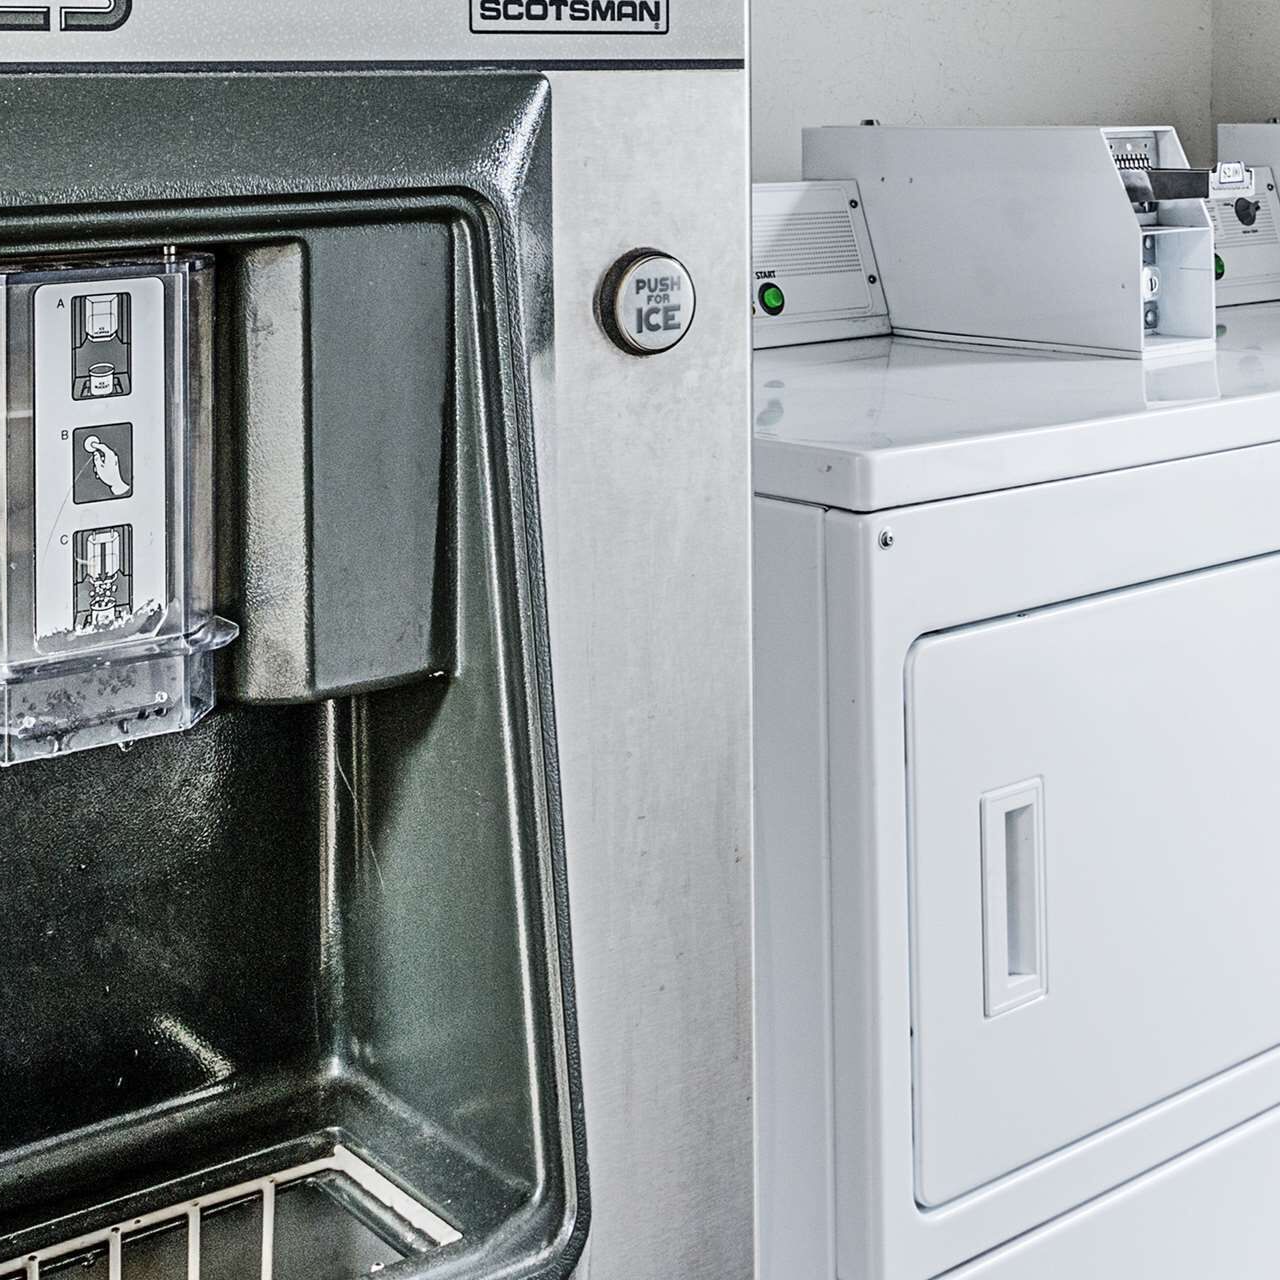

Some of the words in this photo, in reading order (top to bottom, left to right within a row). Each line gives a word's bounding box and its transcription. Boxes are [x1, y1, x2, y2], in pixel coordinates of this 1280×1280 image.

[755, 270, 776, 280] START
[635, 276, 681, 294] PUSH
[56, 298, 65, 309] A
[646, 293, 671, 305] FOR
[636, 304, 681, 334] ICE
[61, 429, 69, 440] B
[60, 534, 69, 545] C
